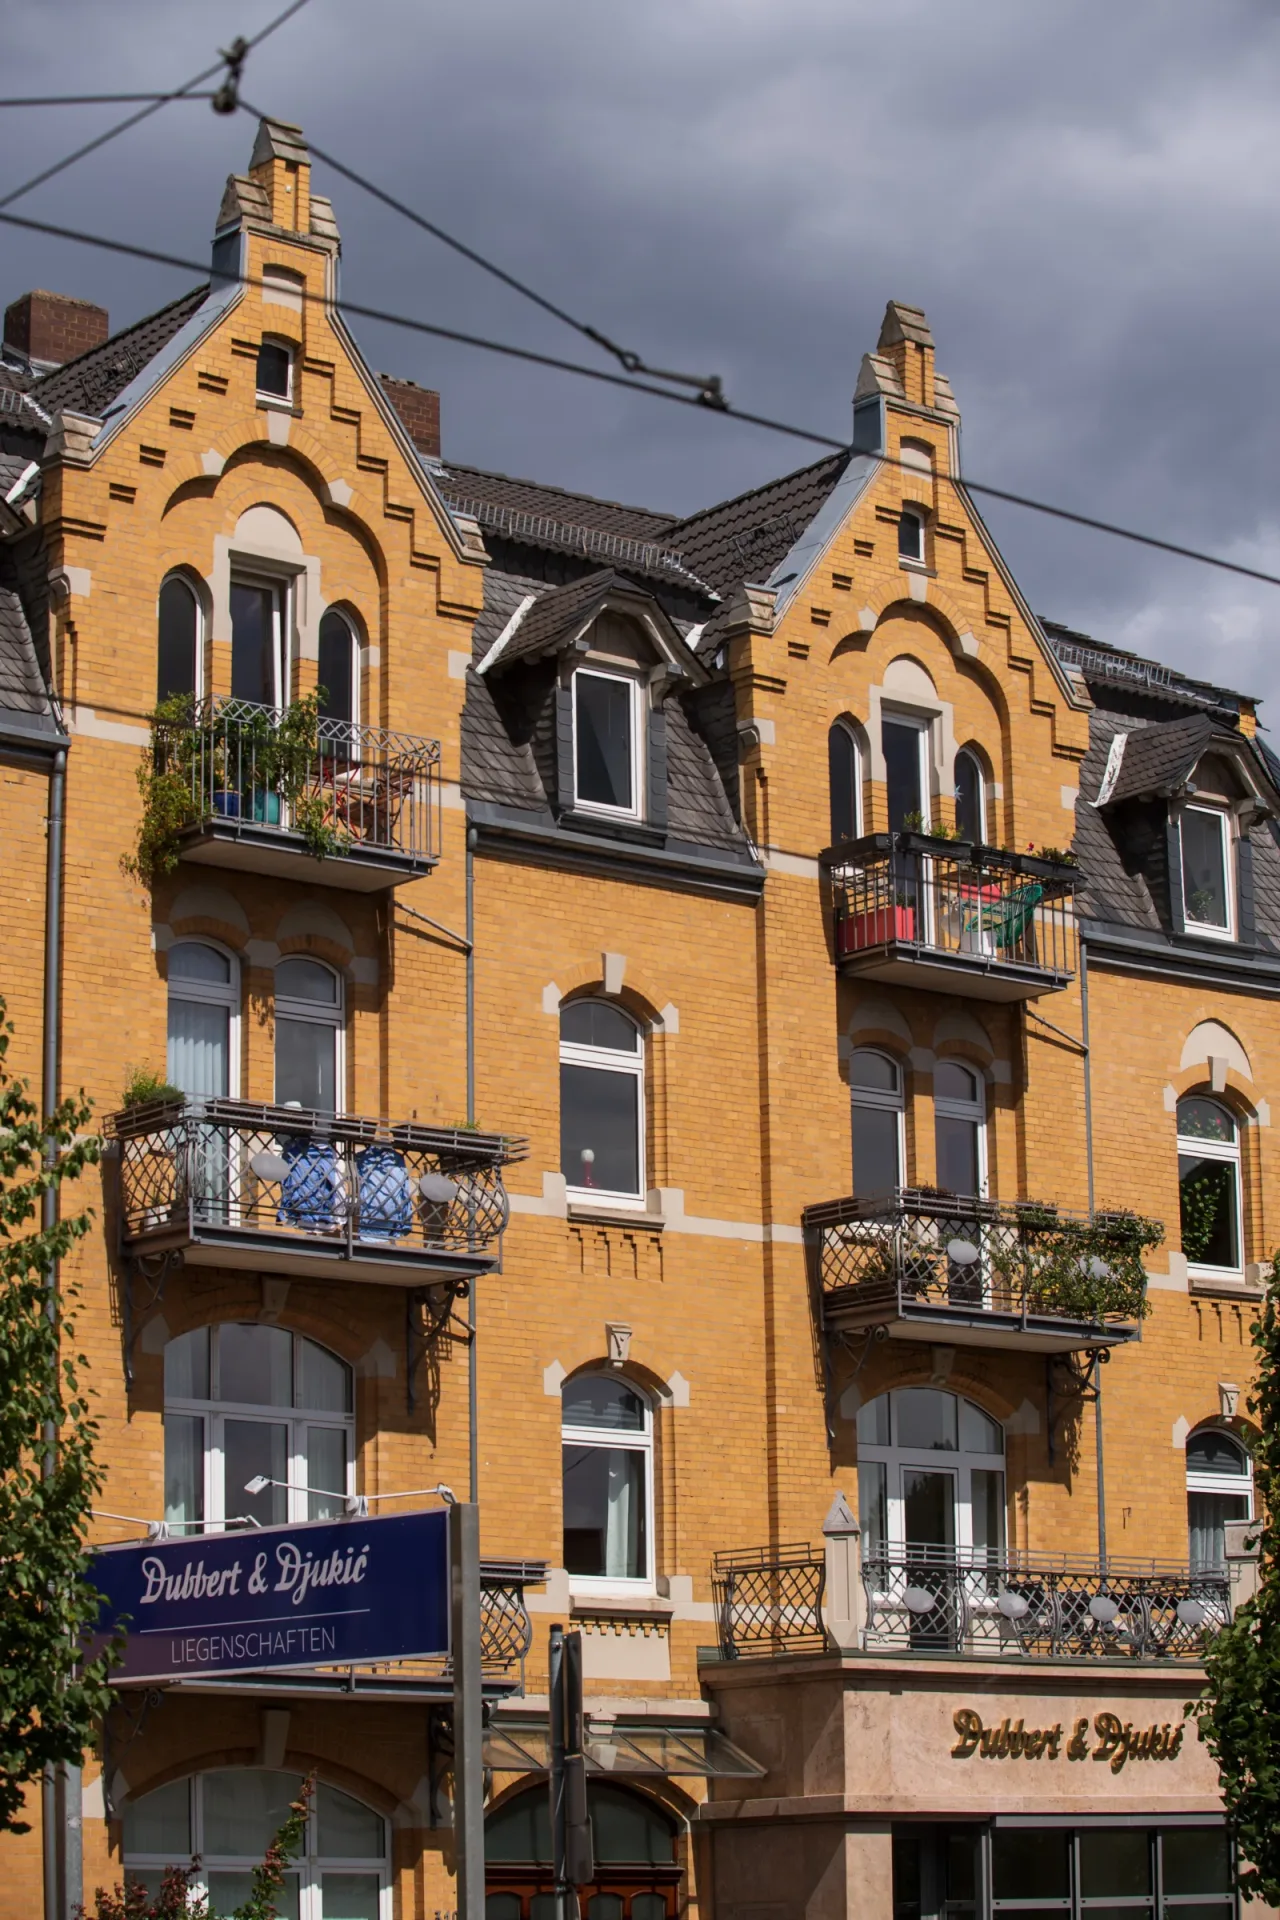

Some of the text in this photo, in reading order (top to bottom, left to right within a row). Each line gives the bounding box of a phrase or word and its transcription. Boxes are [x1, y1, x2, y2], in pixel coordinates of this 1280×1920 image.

[140, 1542, 370, 1605] Dubbert & Djukić
[171, 1626, 336, 1664] LIEGENSCHAFTEN
[951, 1708, 1185, 1774] Dubbert & Djukić
